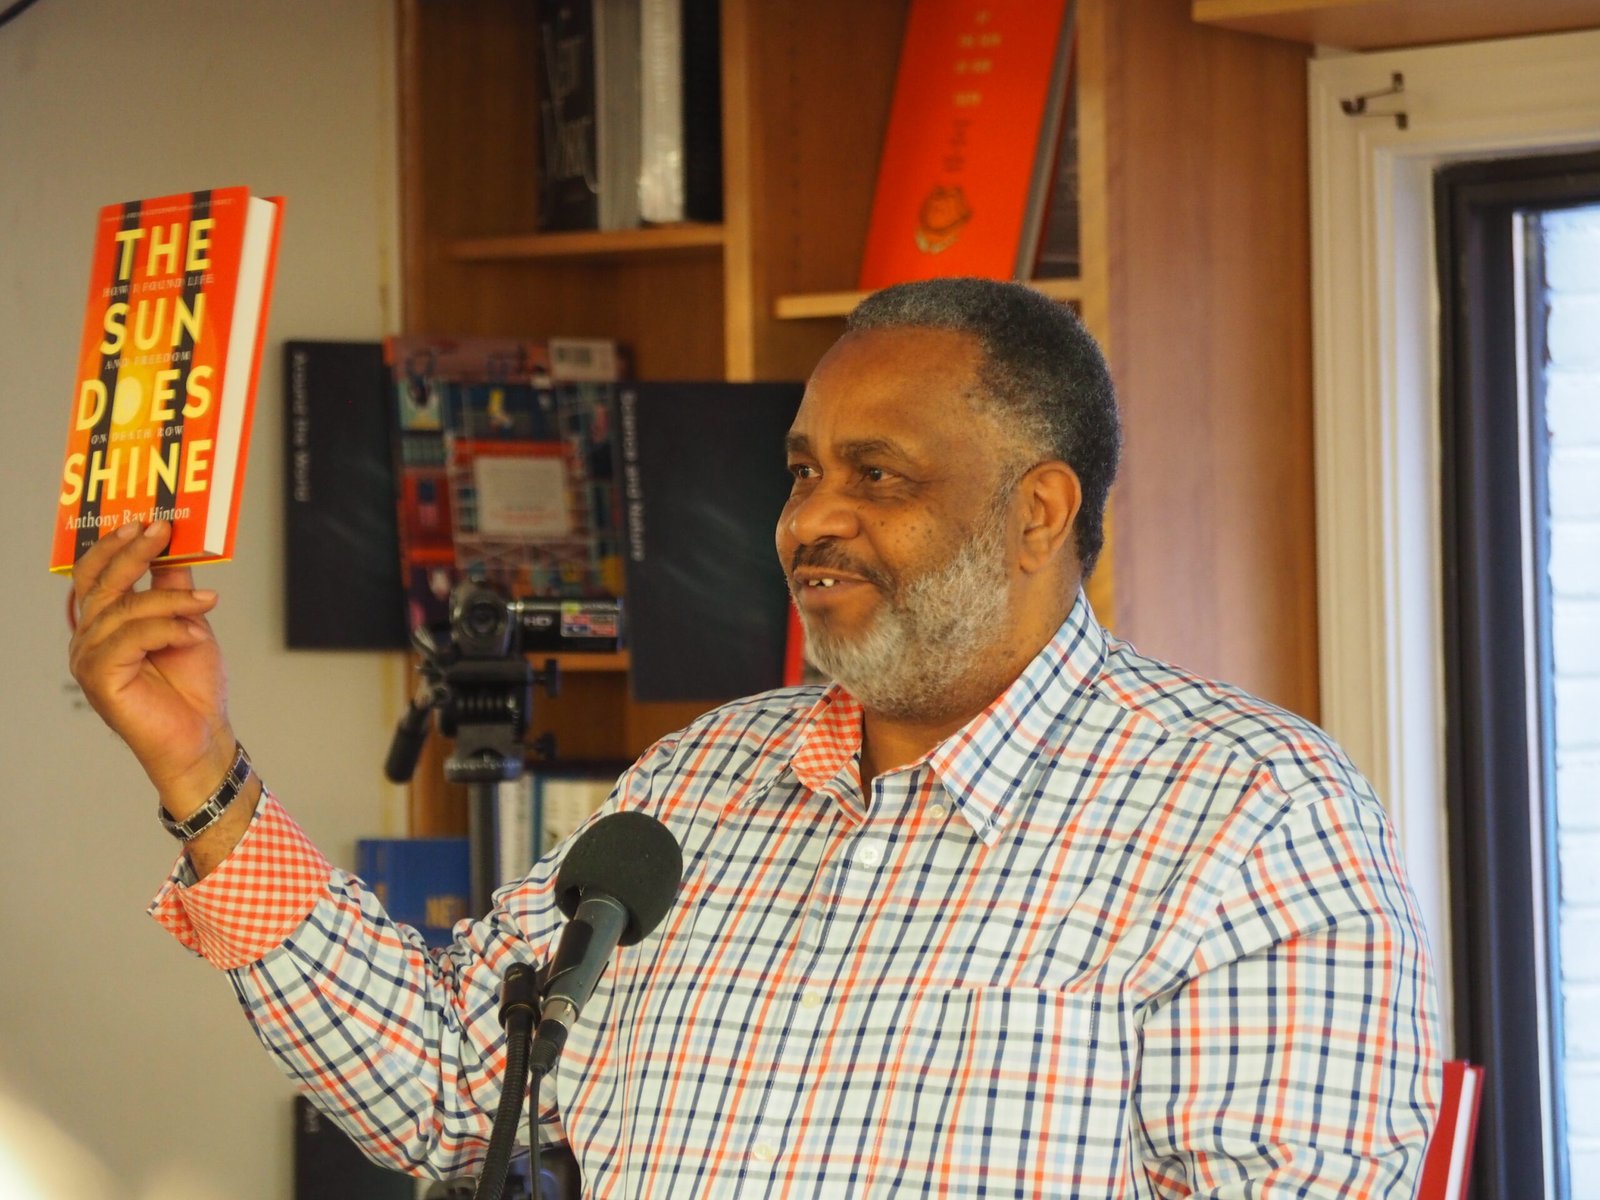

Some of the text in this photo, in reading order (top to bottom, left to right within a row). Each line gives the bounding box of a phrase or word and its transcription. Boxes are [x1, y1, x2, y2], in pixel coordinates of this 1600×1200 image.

[115, 218, 215, 281] THE
[102, 284, 128, 298] HOW
[142, 277, 184, 293] FOUND
[187, 273, 214, 287] LIFE
[100, 293, 206, 355] SUN
[104, 350, 191, 370] AND FREEDOM
[76, 364, 214, 432] DOES
[91, 425, 184, 445] ON DEATH ROW
[59, 438, 213, 506] SHINE
[65, 506, 190, 531] Anthony Ray Hinton
